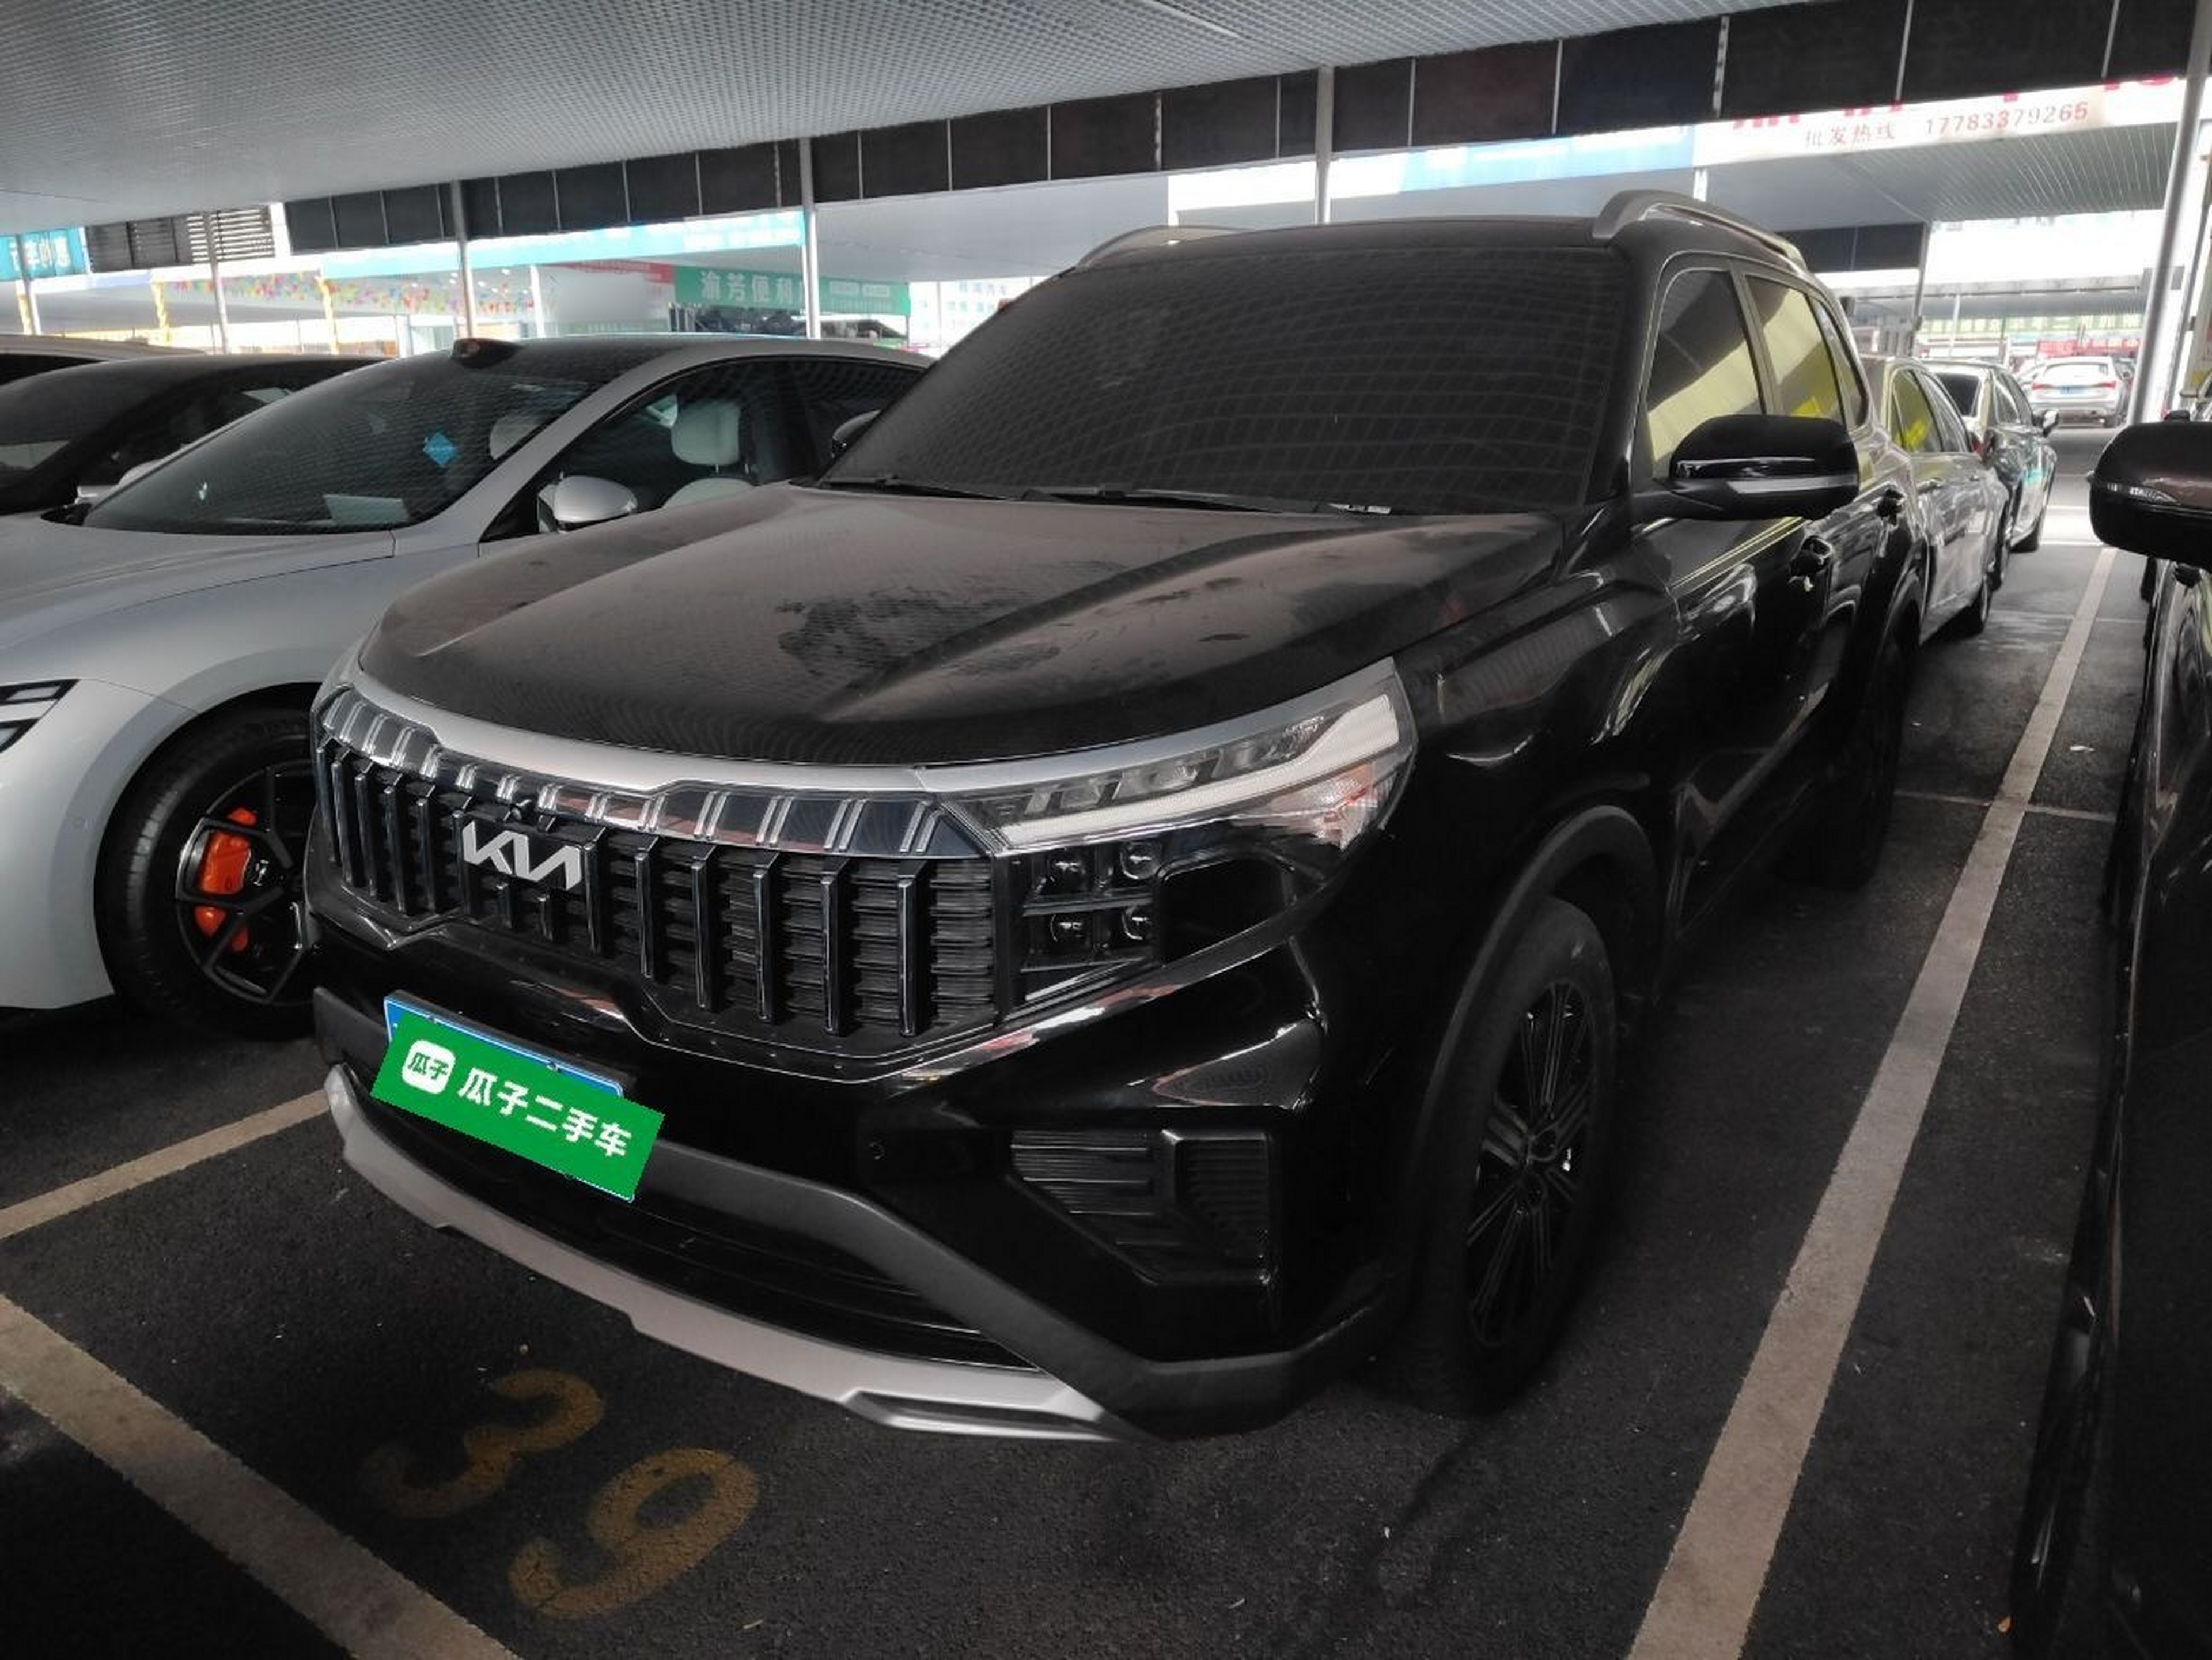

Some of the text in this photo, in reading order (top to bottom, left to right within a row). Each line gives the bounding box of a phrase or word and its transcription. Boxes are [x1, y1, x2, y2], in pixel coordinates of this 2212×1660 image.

[1926, 101, 2089, 135] 17783379265
[700, 270, 805, 305] 渝芳便利
[462, 820, 582, 891] KIA
[358, 1368, 760, 1618] 39
